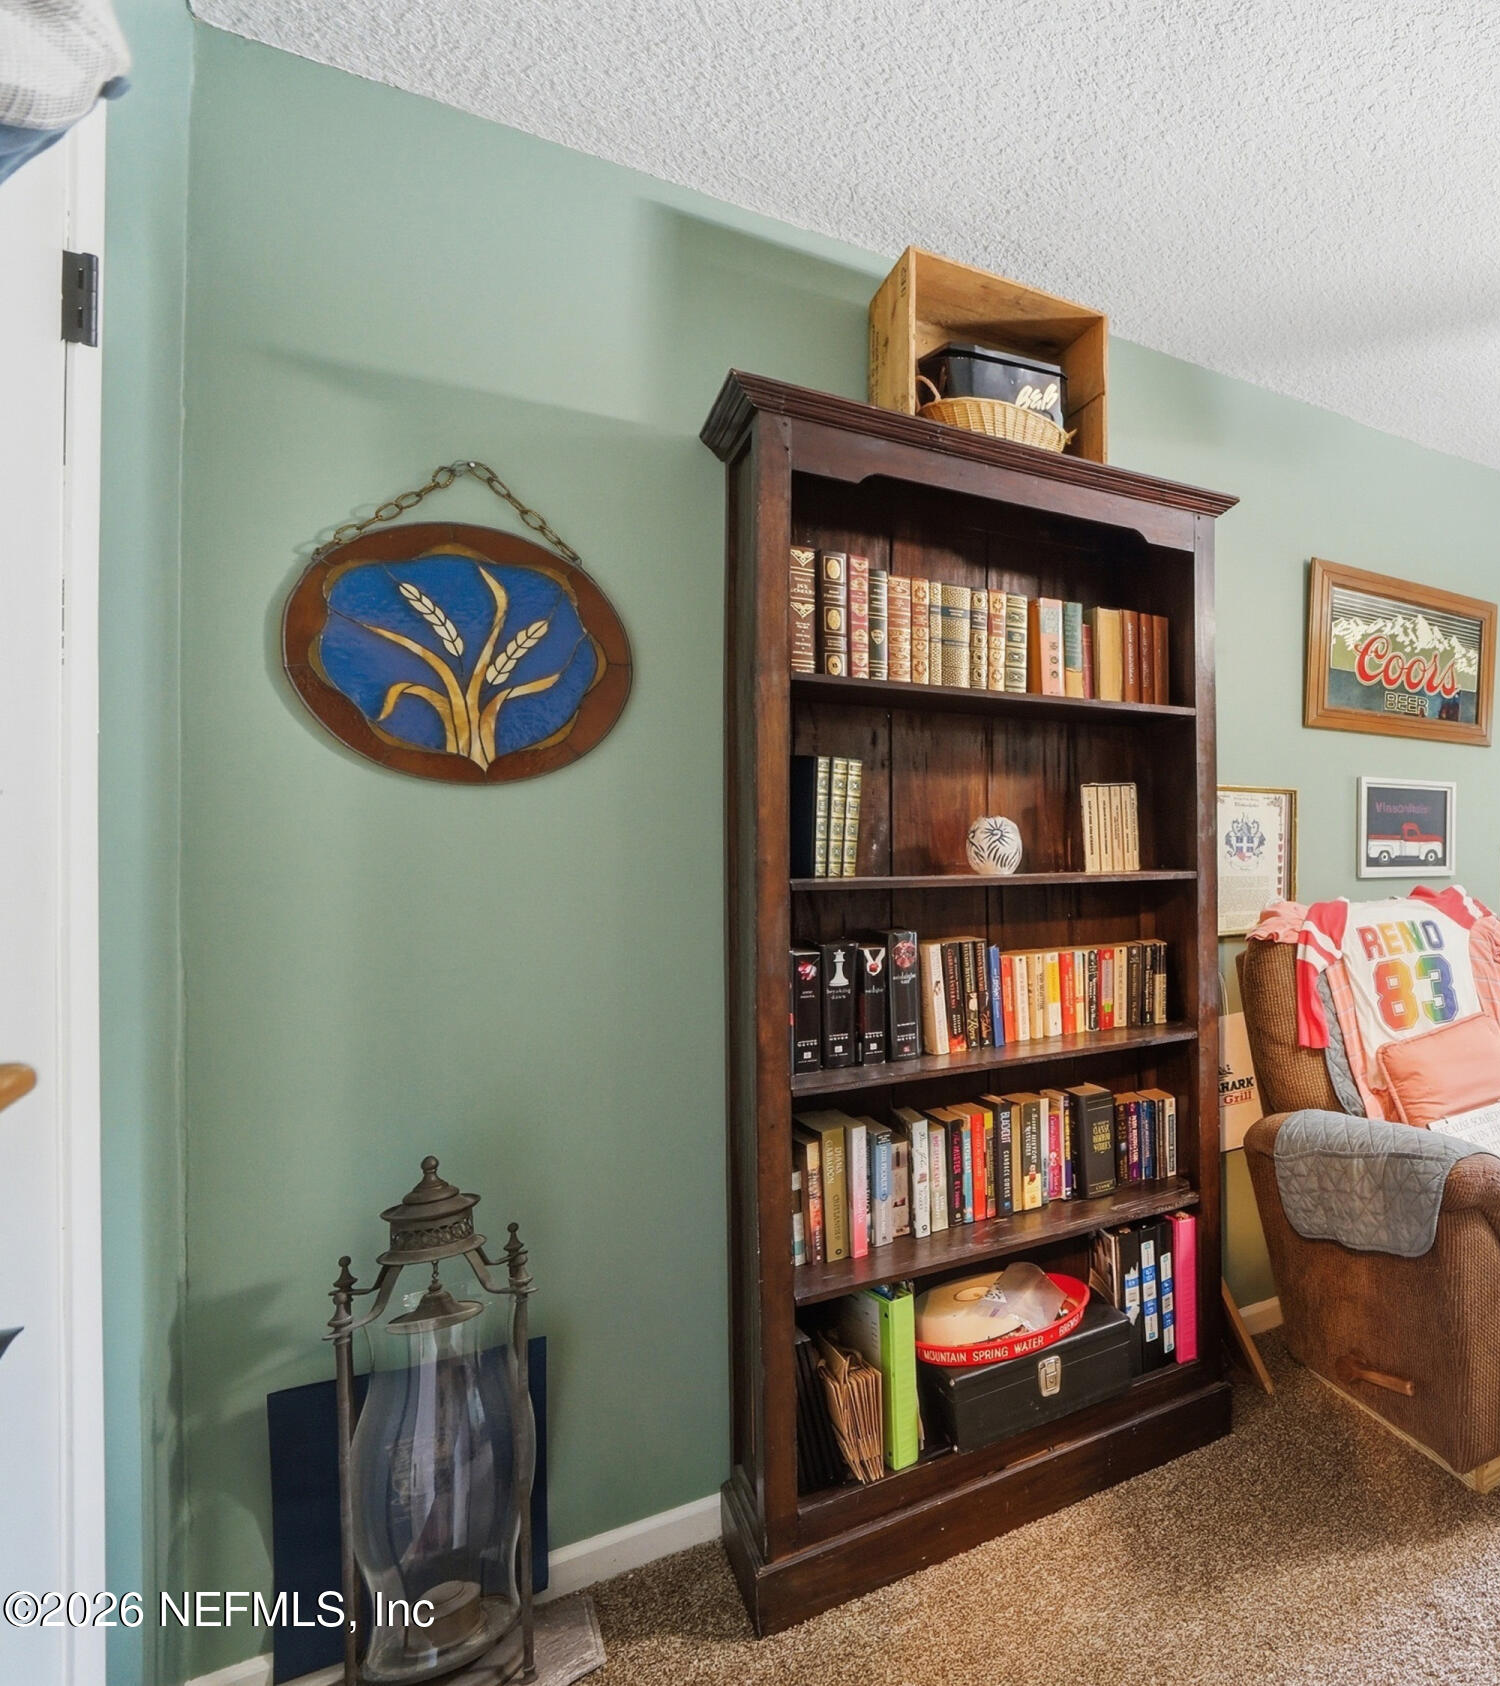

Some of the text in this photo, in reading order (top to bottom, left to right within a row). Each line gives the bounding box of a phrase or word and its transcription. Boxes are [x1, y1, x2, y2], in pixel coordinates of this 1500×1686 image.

[1353, 634, 1460, 698] Coors
[1384, 690, 1429, 715] BEER
[1356, 919, 1444, 961] RENO
[1373, 953, 1459, 1031] 83
[1219, 1077, 1254, 1093] HARK
[1224, 1091, 1252, 1104] Grill
[834, 1146, 843, 1175] DIANA
[923, 1350, 967, 1363] MOUNTAIN
[972, 1346, 1009, 1362] SPRING
[1014, 1335, 1045, 1354] WATER
